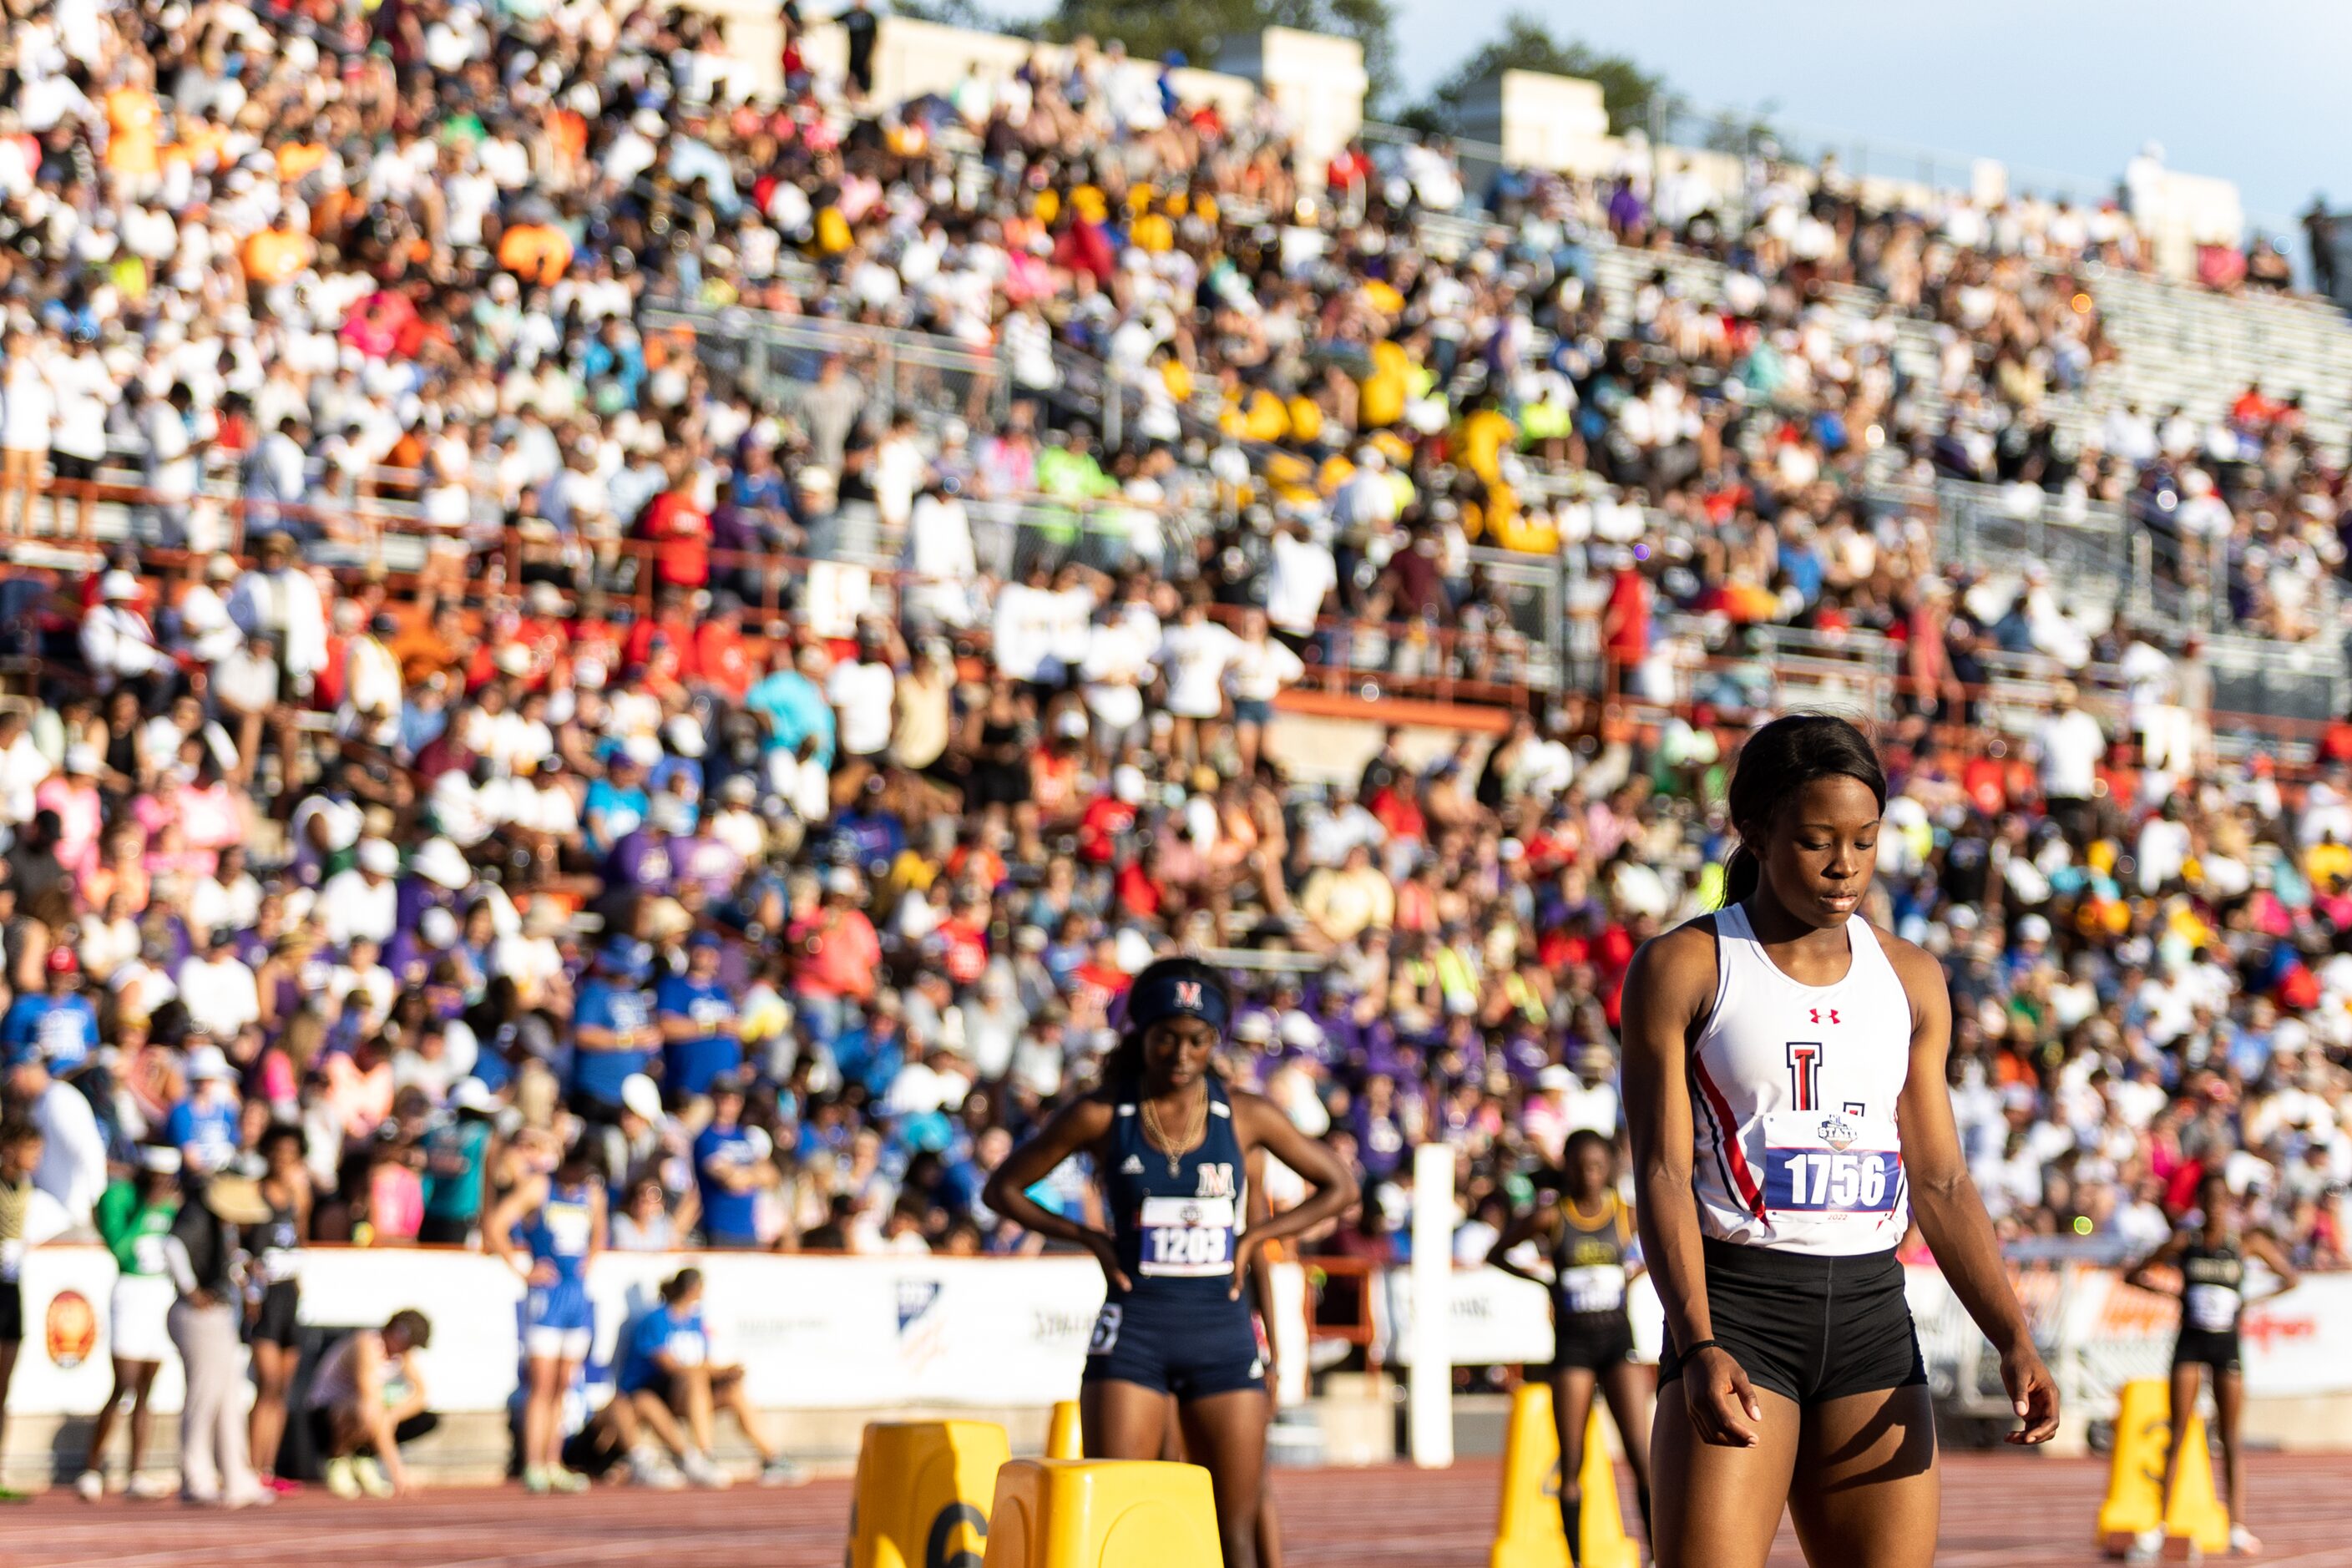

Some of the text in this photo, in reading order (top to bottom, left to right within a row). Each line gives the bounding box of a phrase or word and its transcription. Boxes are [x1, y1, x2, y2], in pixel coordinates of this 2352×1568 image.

[1173, 980, 1204, 1010] M
[1195, 1161, 1236, 1198] M
[1784, 1153, 1886, 1206] 1756
[1827, 1213, 1849, 1222] 2022
[1150, 1227, 1227, 1264] 1203
